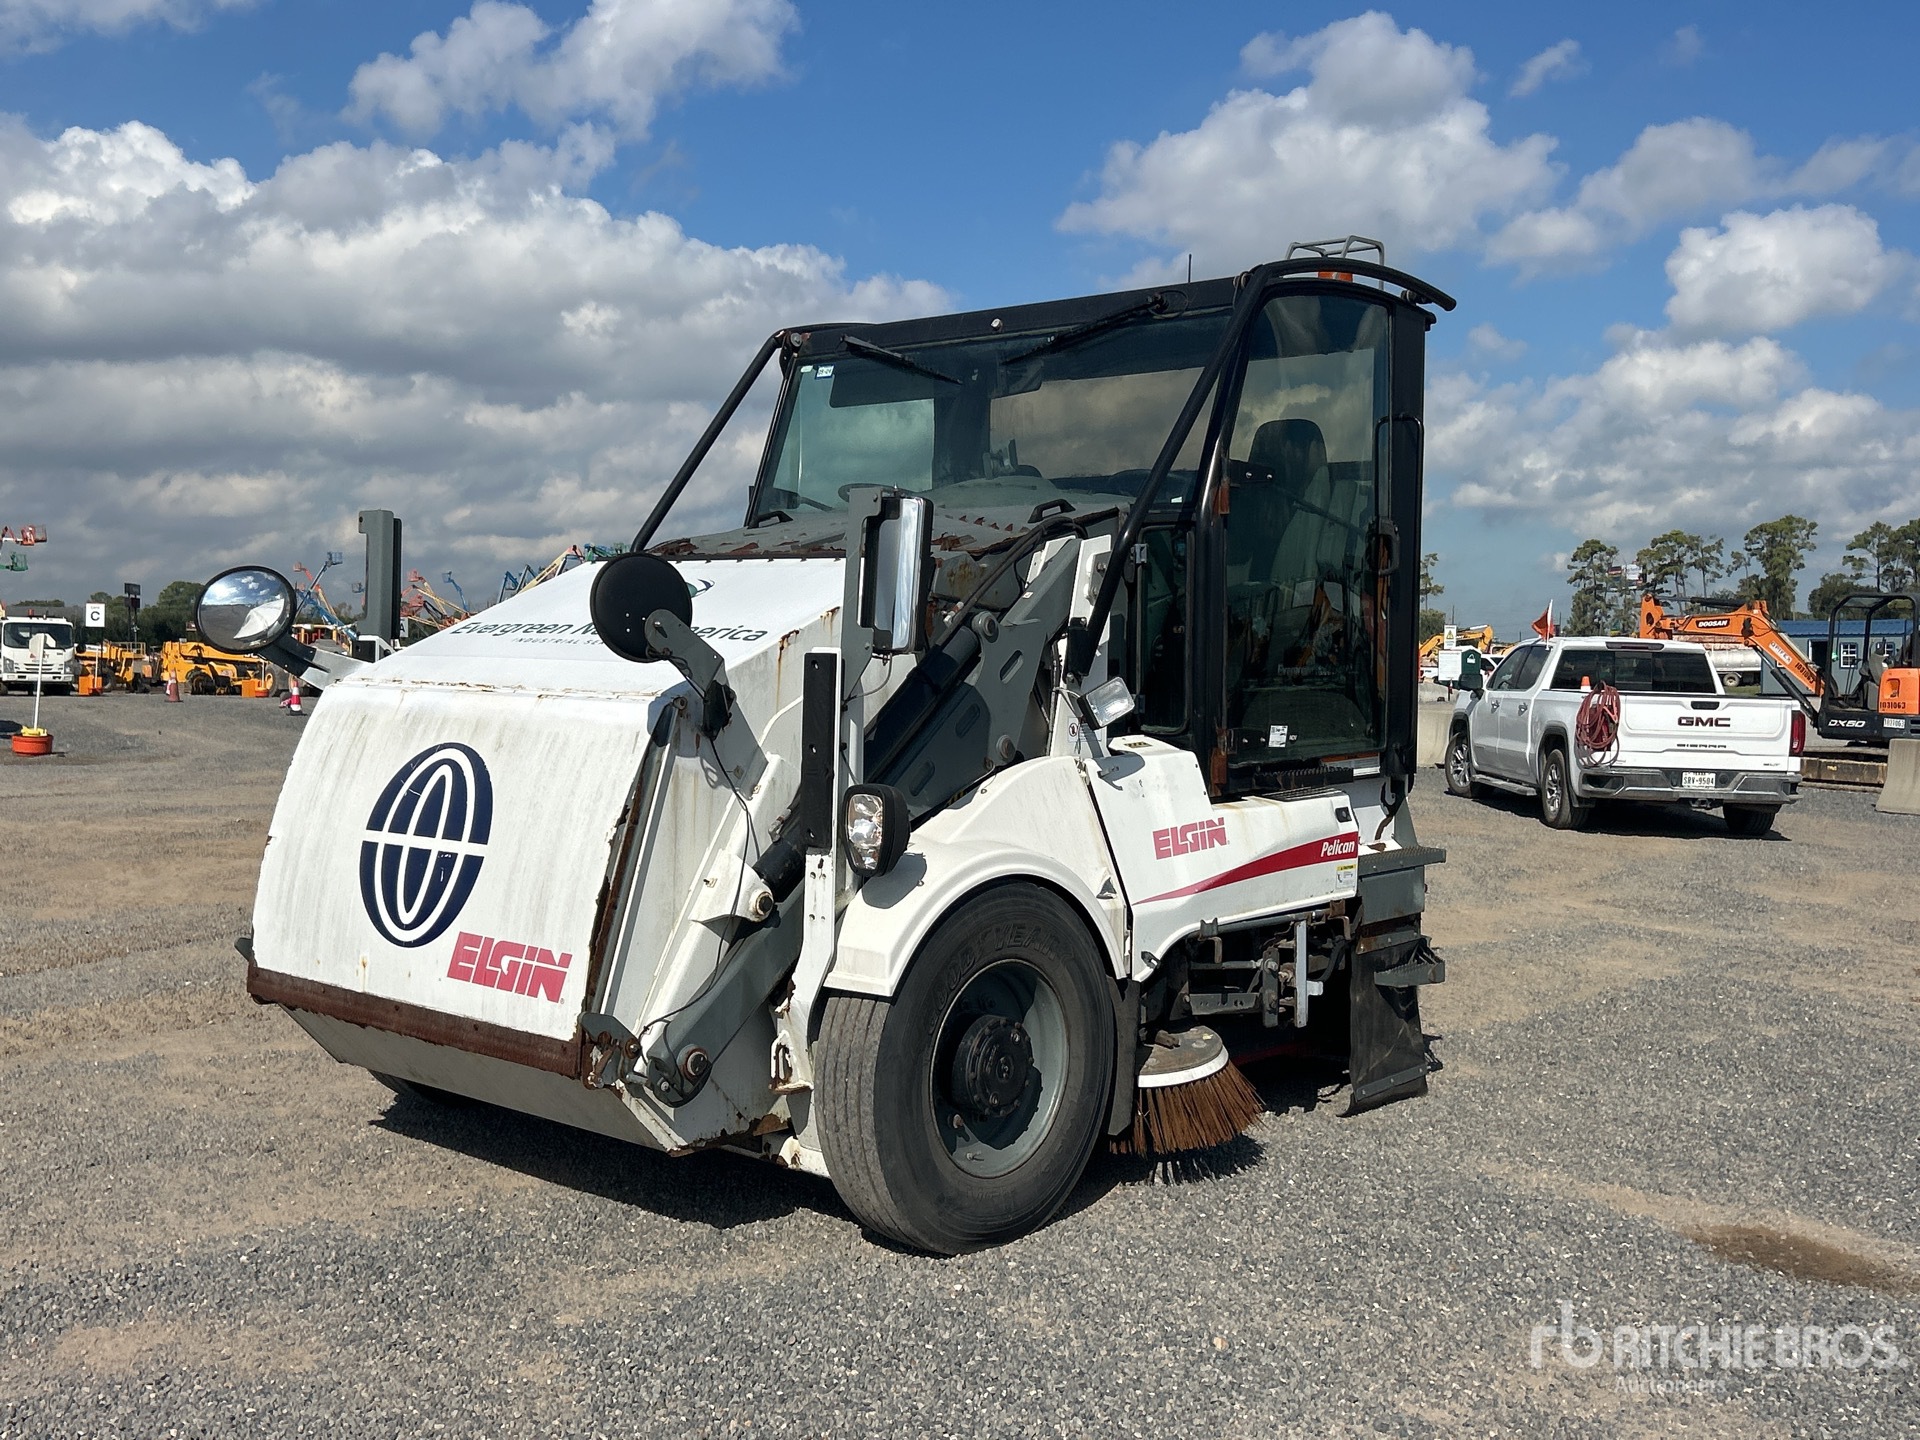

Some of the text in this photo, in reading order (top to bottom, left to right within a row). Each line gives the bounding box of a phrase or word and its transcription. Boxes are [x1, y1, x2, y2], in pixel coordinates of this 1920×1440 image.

[90, 611, 100, 621] C
[449, 621, 574, 637] Evergreen
[690, 625, 768, 641] erica
[512, 637, 579, 645] INDUSTRIAL
[1879, 701, 1906, 709] 1031063
[1678, 716, 1731, 727] GMC
[1683, 776, 1714, 785] SRV-9504
[1152, 817, 1227, 860] ELGIN
[1320, 839, 1356, 857] Pelican
[447, 931, 573, 1003] ELGIN
